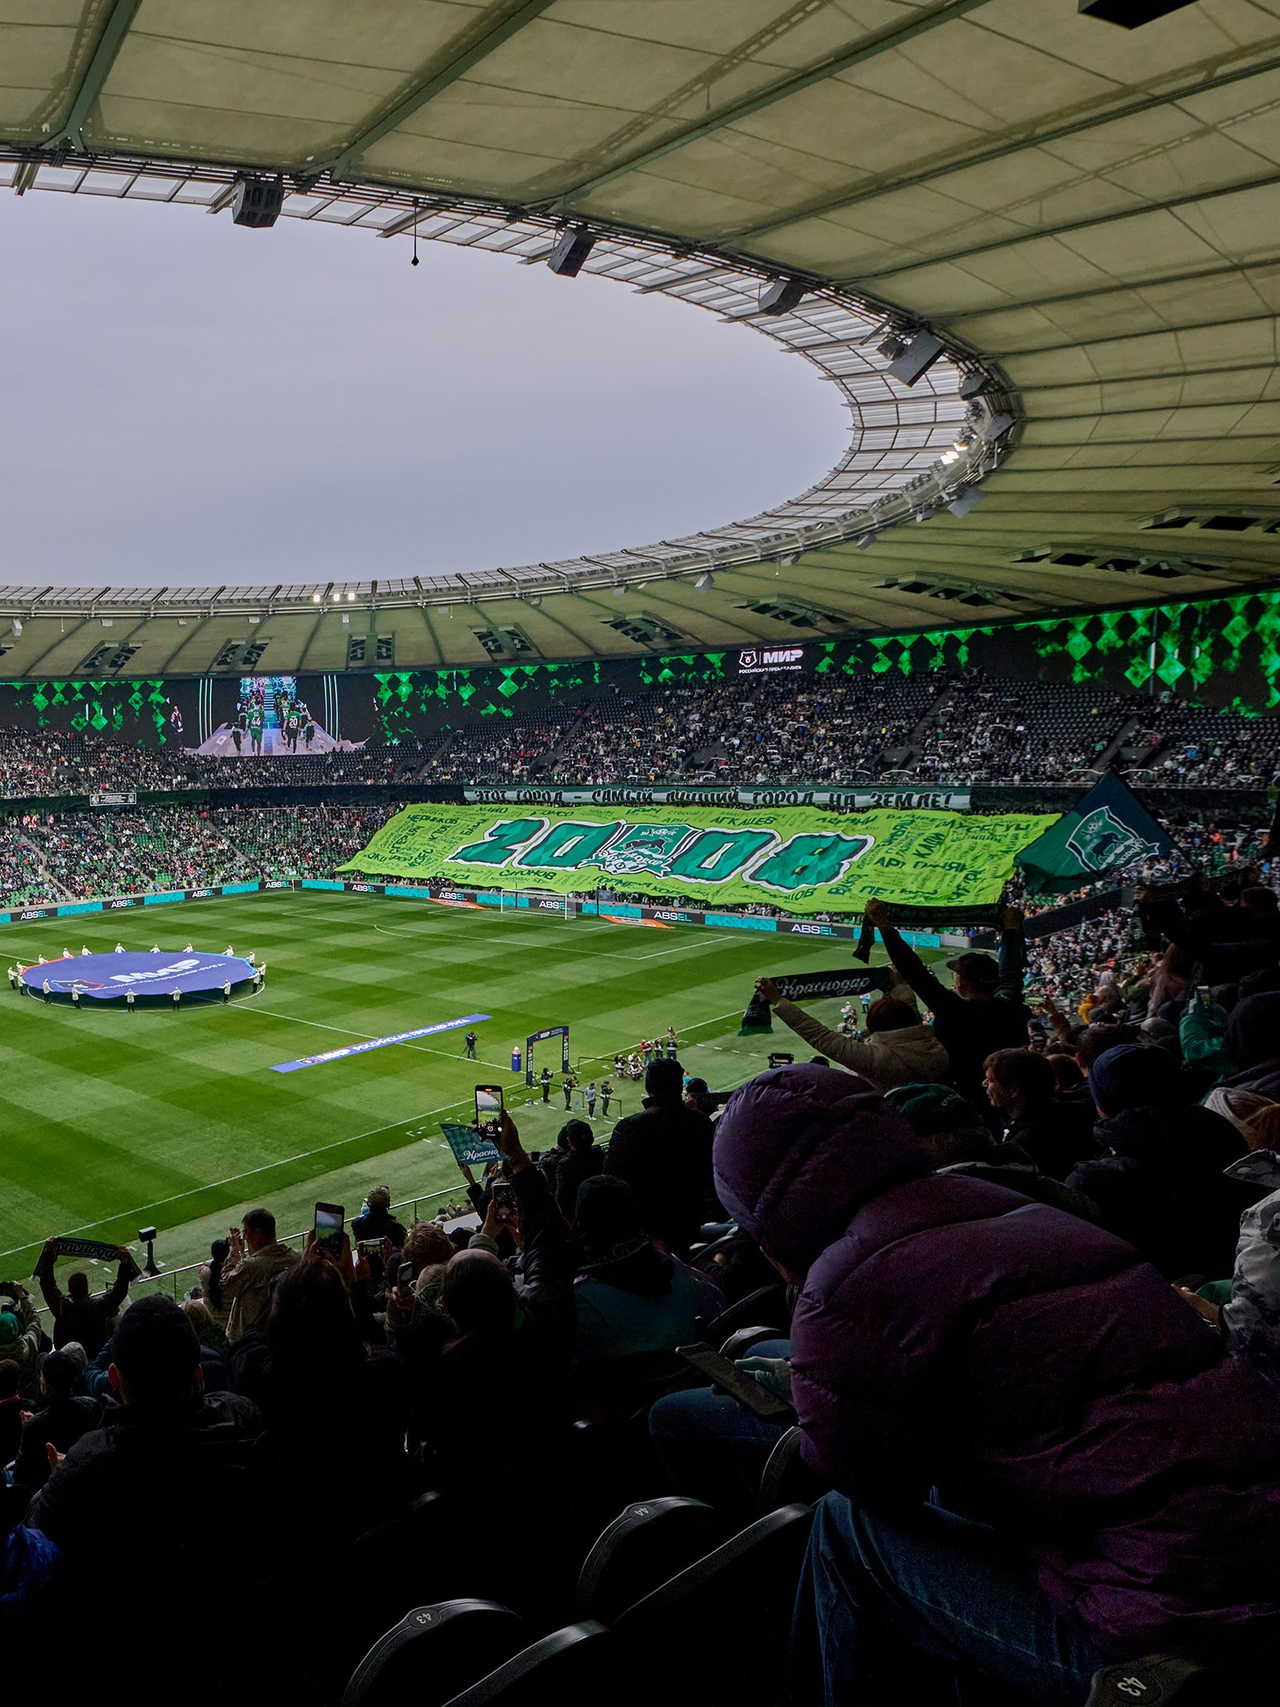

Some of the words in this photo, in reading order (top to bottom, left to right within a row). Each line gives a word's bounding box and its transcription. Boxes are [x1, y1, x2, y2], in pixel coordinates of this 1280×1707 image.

[763, 650, 803, 664] МИР
[474, 789, 507, 801] ЭТОТ
[516, 788, 563, 803] ГОРОД
[592, 787, 654, 803] САМЫЙ
[665, 787, 741, 804] ЛУЧШИЙ
[752, 791, 815, 805] ГОРОД
[828, 792, 856, 807] НА
[870, 791, 952, 807] ЗЕМЛЕ!
[265, 880, 292, 889] ABSEL
[191, 889, 215, 899] ABSEL
[439, 891, 467, 900] ABSEL
[111, 899, 136, 908] ABSEL
[539, 900, 570, 910] ABSEL
[20, 910, 48, 920] ABSEL
[653, 911, 692, 922] ABSEL
[791, 923, 838, 936] ABSEL
[109, 959, 201, 983] МИР
[776, 977, 871, 1000] Краснодар
[634, 1507, 649, 1517] 44
[416, 1613, 432, 1624] 43
[1117, 1676, 1148, 1697] 43
